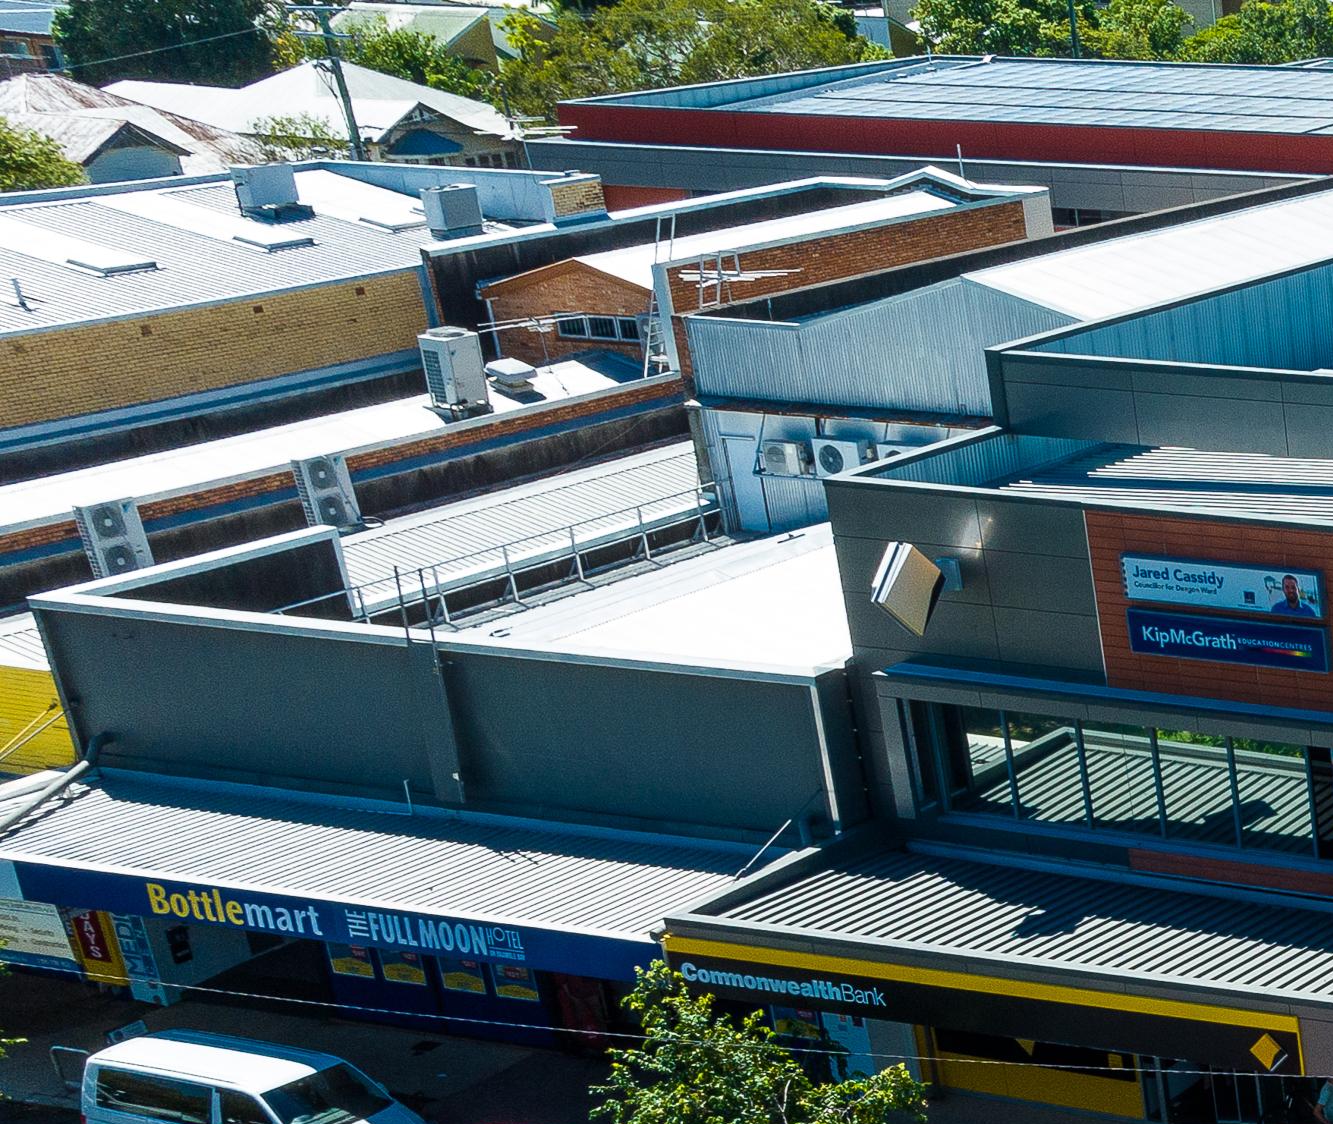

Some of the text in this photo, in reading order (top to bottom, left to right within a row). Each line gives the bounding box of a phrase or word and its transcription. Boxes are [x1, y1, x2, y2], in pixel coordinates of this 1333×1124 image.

[1132, 565, 1224, 588] Jared Cassidy
[146, 883, 324, 936] Bottlemart
[345, 909, 525, 955] THE FULL MOON HOTEL
